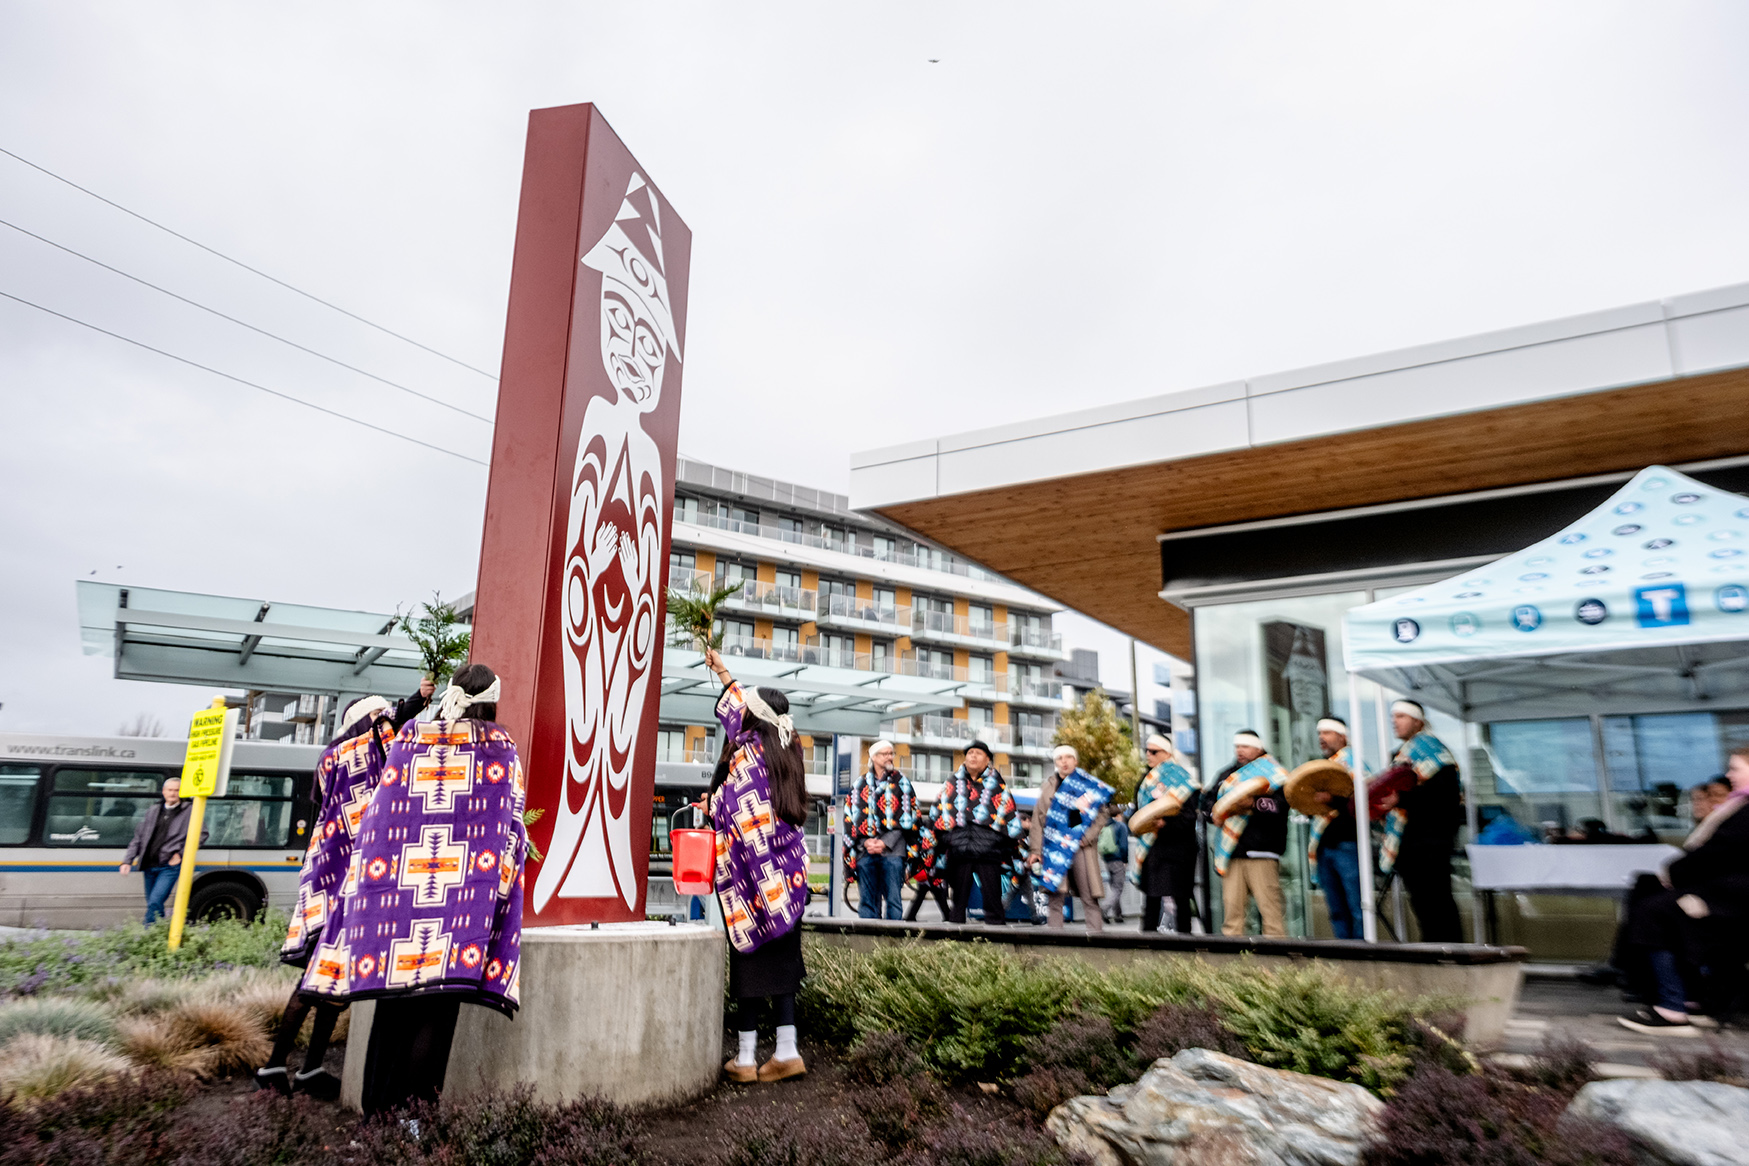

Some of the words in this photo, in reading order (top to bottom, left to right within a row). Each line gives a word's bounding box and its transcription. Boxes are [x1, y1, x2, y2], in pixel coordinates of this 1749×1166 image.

[1640, 588, 1680, 622] T
[194, 715, 223, 727] WARNING
[201, 727, 222, 737] PRESSURE
[200, 738, 218, 748] PIPELINE
[7, 744, 137, 759] www.translink.ca
